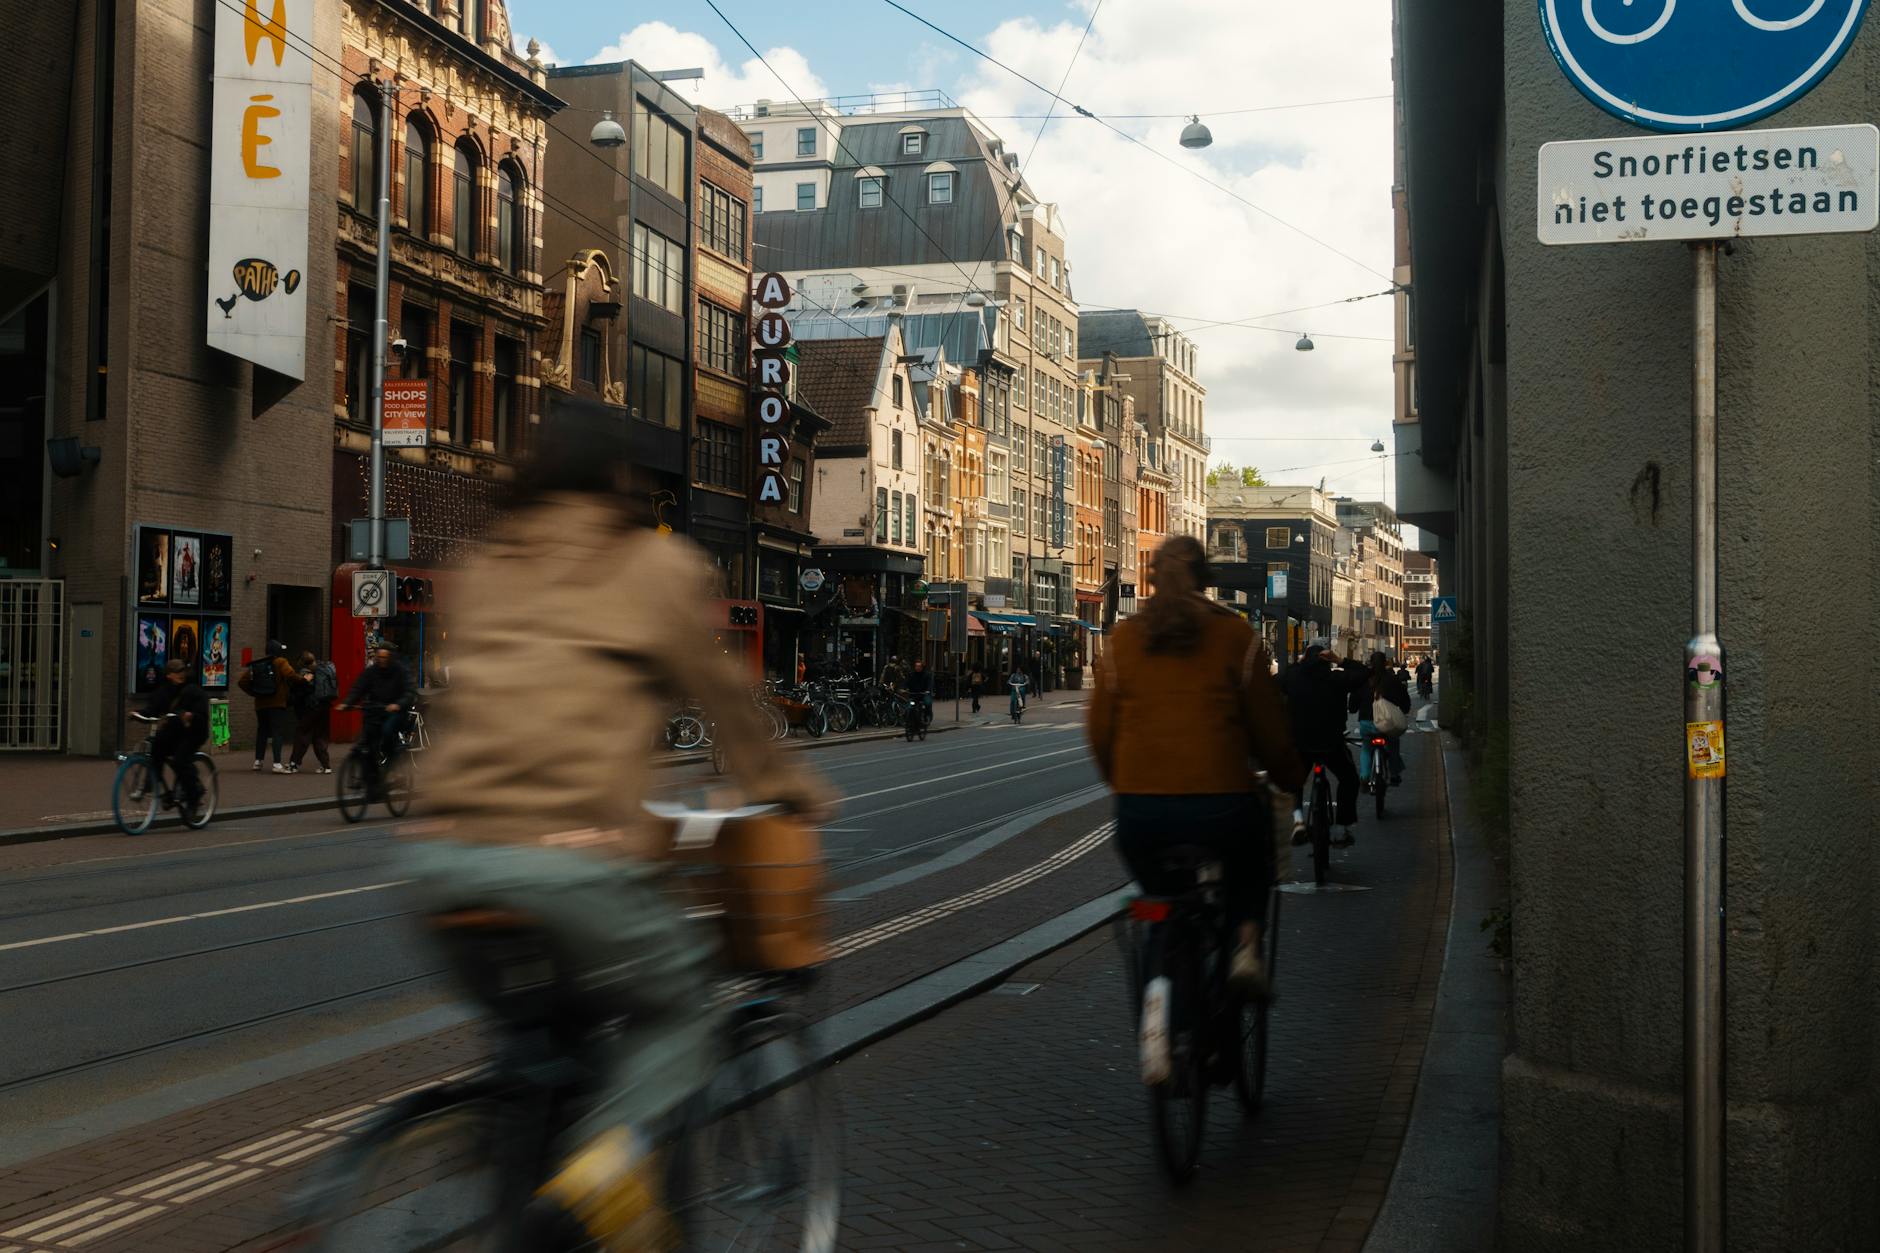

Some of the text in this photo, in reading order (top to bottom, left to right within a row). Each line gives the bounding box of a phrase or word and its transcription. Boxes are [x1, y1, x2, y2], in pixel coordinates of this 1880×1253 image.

[1593, 144, 1818, 179] Snorfietsen
[1554, 188, 1859, 227] niet toegestaan
[384, 390, 427, 401] SHOPS
[760, 277, 783, 501] AURORA
[1054, 452, 1062, 544] THE ALBUS
[362, 589, 379, 599] 30
